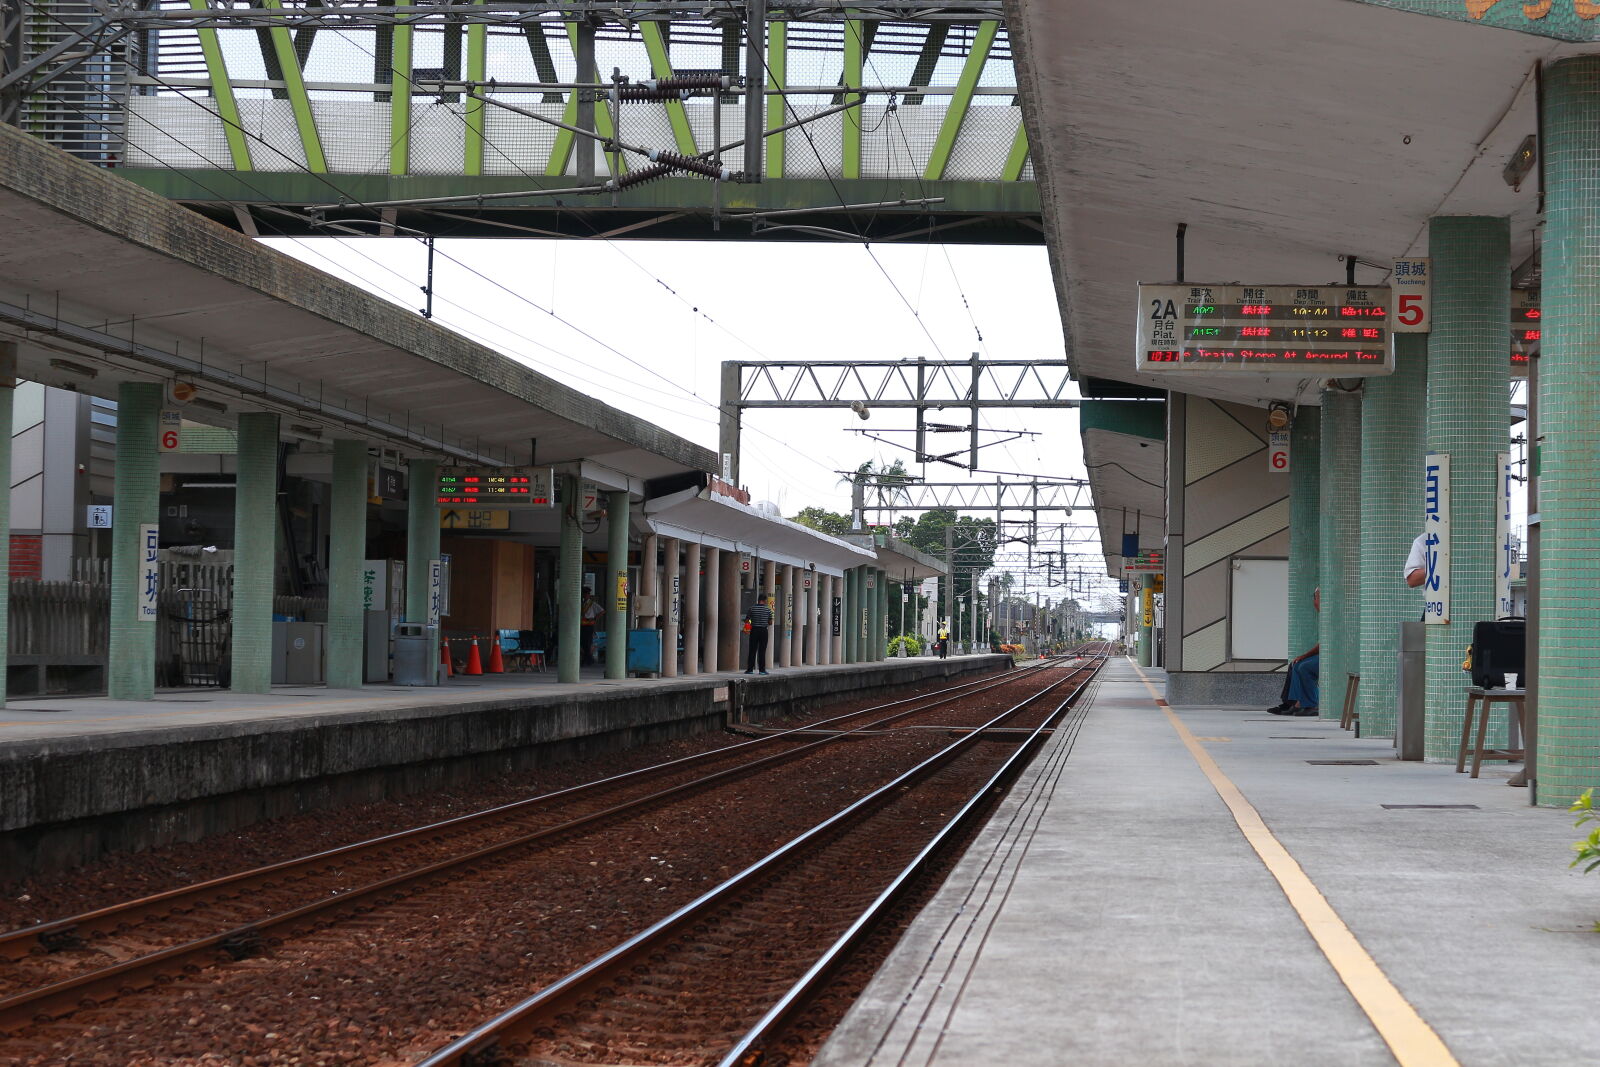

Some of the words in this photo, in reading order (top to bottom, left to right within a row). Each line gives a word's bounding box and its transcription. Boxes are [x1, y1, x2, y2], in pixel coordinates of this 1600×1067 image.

[1395, 261, 1426, 276] 頭城
[1396, 278, 1425, 286] Toucheng
[1190, 287, 1212, 298] 車次
[1243, 288, 1265, 299] 開往
[1296, 289, 1319, 300] 時間
[1151, 299, 1178, 320] 2A
[1397, 294, 1424, 326] 5
[1154, 320, 1175, 331] 月台
[1153, 330, 1175, 339] Plat.
[162, 430, 178, 449] 6
[1272, 451, 1288, 469] 6
[584, 495, 595, 509] 7
[468, 510, 491, 529] 出口
[742, 561, 750, 571] 8
[804, 579, 811, 588] 9
